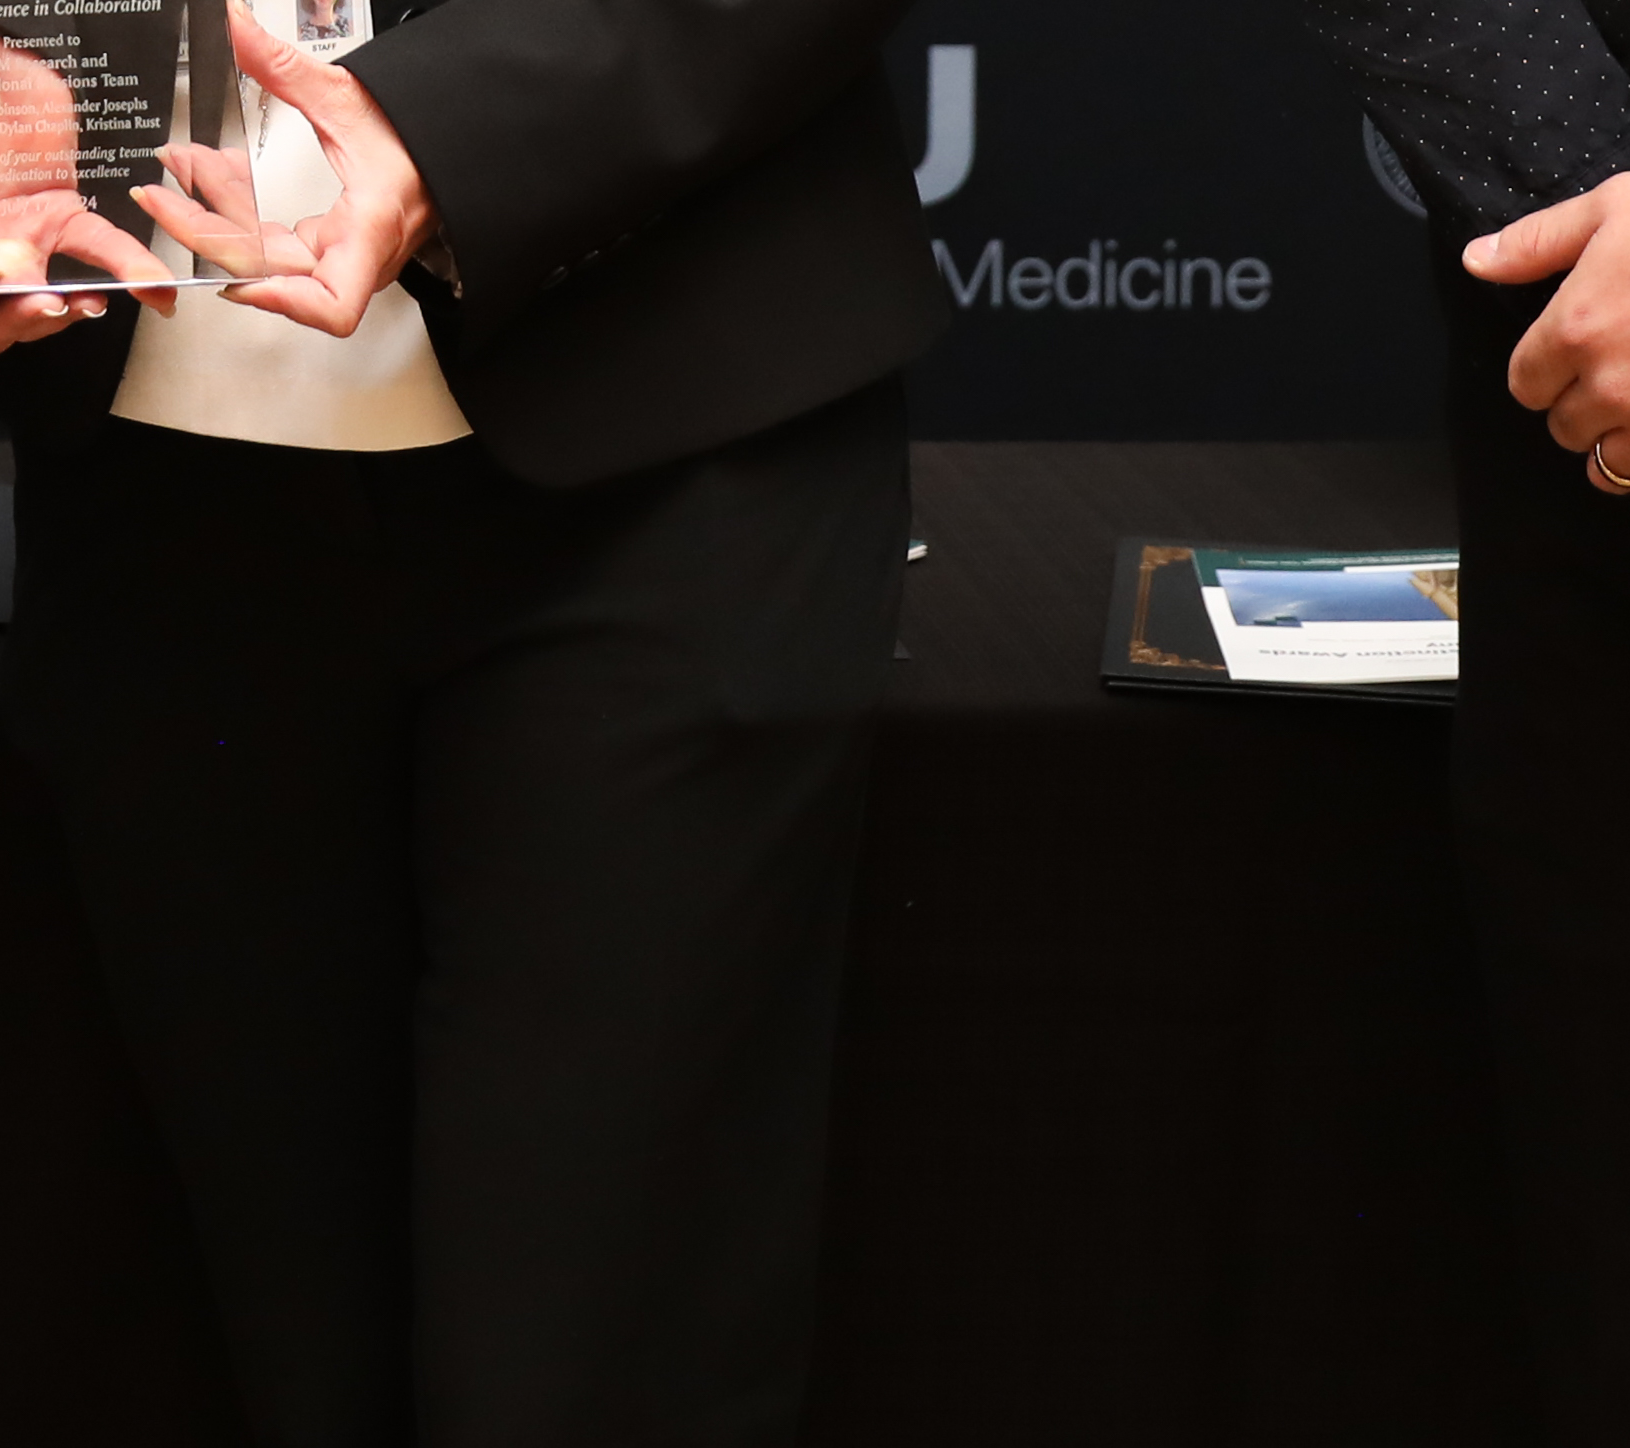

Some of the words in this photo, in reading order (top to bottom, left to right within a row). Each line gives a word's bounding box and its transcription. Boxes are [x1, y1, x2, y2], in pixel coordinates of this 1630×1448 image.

[33, 0, 49, 17] in
[3, 33, 64, 48] Presented
[67, 35, 81, 46] to
[312, 42, 338, 53] STAFF
[80, 52, 109, 68] and
[100, 73, 139, 88] Team
[102, 97, 149, 116] Josephs
[86, 116, 132, 131] Kristina
[134, 115, 161, 130] Rust
[12, 150, 42, 166] your
[44, 147, 116, 162] outstanding
[55, 168, 69, 180] to
[71, 165, 131, 179] excellence
[931, 238, 1272, 309] Medicine
